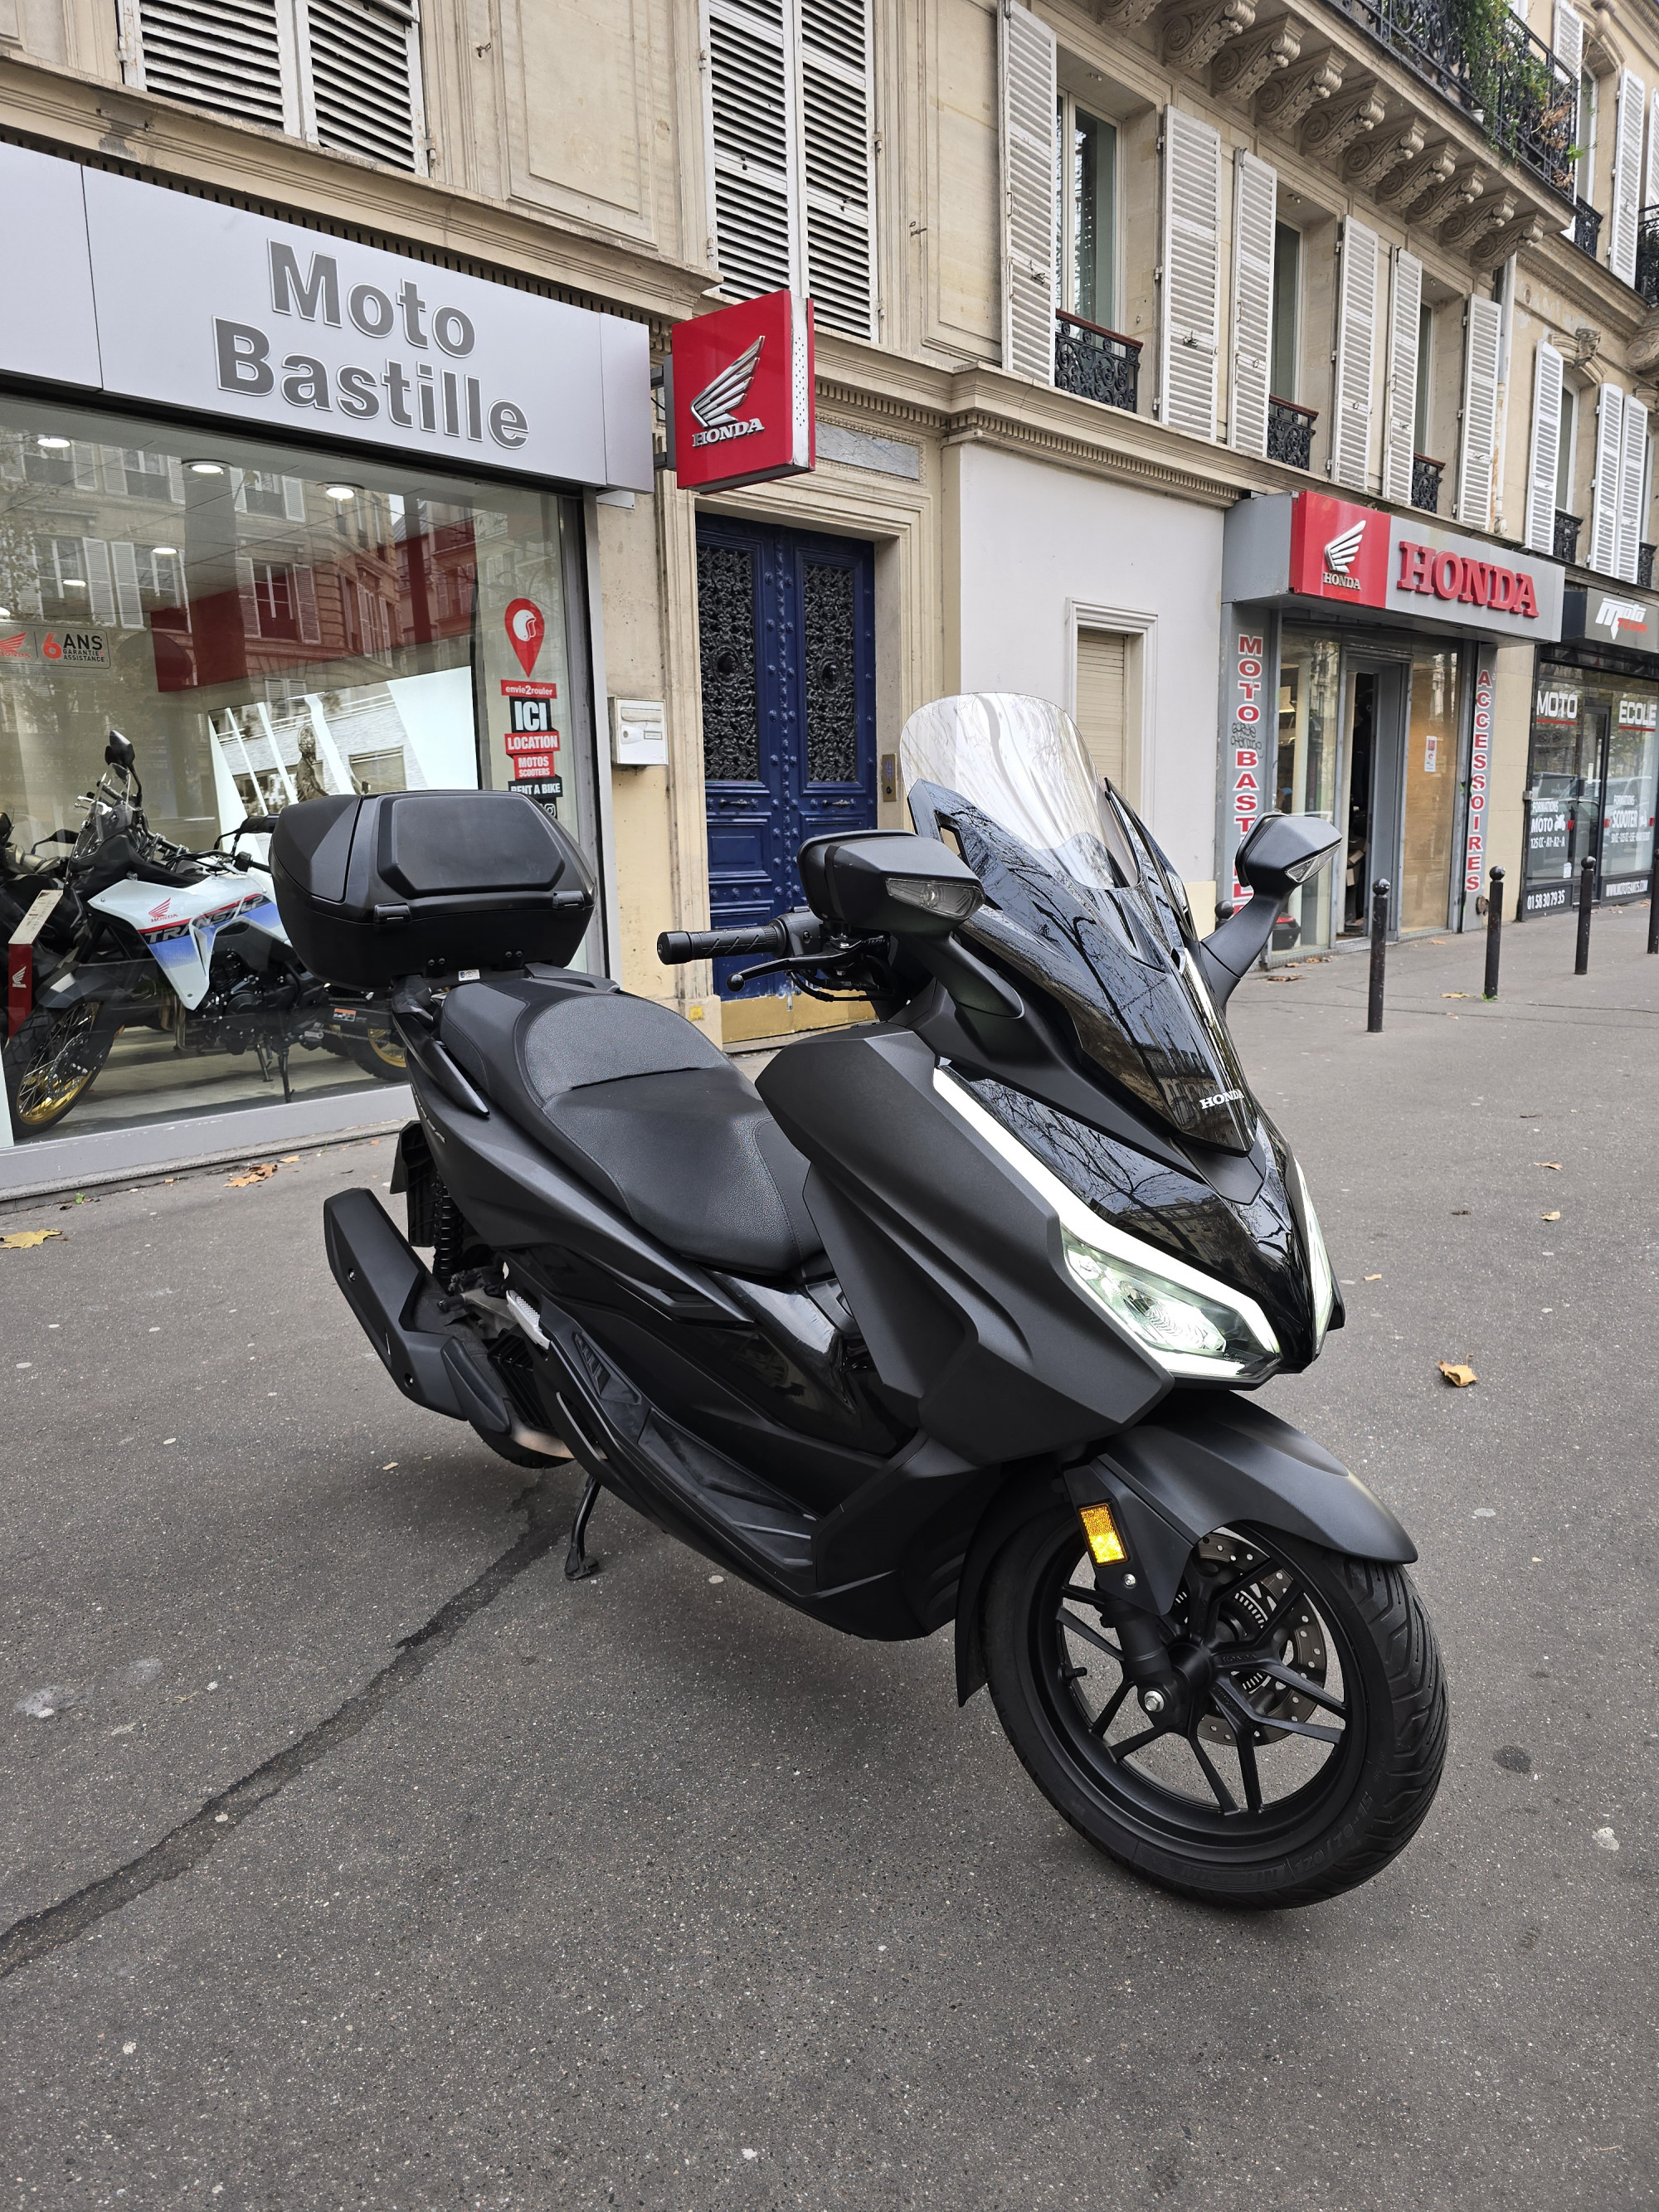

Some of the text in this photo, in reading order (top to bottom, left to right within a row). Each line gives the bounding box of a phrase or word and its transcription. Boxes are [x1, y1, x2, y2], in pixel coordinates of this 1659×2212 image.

[267, 238, 475, 358] Moto
[212, 315, 529, 450] Bastille
[692, 418, 765, 447] HONDA
[1323, 571, 1361, 591] HONDA
[1397, 541, 1540, 618] HONDA
[42, 632, 103, 659] 6 ANS
[1236, 634, 1262, 724] MOTO
[505, 684, 552, 696] envie2rouler
[1536, 690, 1579, 719] MOTO
[513, 701, 547, 732] ICI
[508, 735, 558, 751] LOCATION
[518, 756, 549, 768] MOTOS
[518, 767, 550, 778] SCOOTERS
[1466, 669, 1492, 892] ACCESSOIRES
[533, 784, 541, 795] A
[541, 783, 561, 794] BIKE
[1530, 817, 1553, 833] MOTO
[1612, 809, 1637, 828] SCOOTER
[151, 913, 178, 922] HONDA
[1199, 1089, 1244, 1109] HONDA
